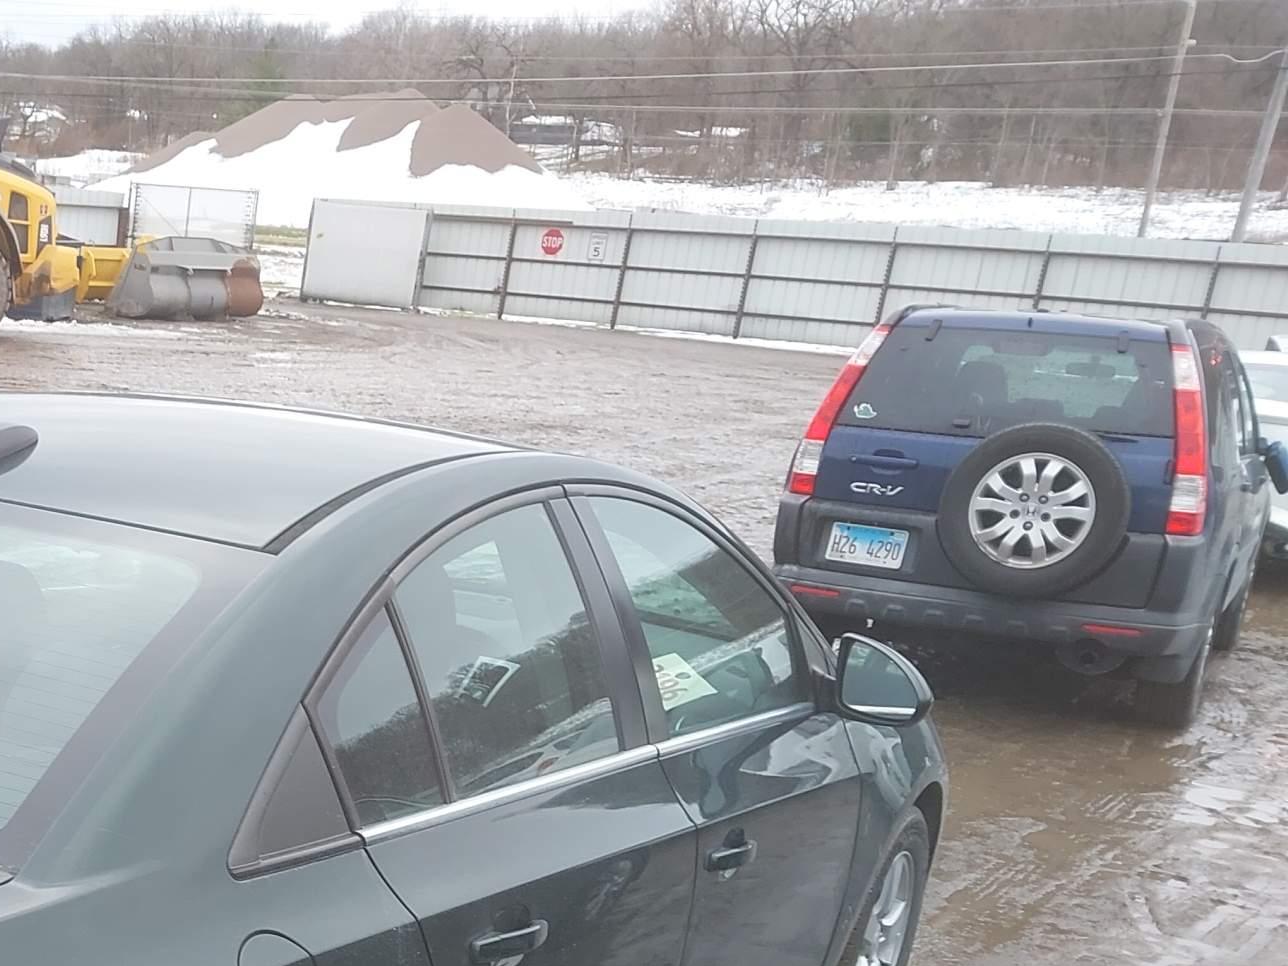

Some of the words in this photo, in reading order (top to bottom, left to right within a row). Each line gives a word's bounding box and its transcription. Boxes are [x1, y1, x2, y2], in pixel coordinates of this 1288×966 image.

[542, 236, 563, 248] STOP
[592, 246, 601, 257] 5
[850, 482, 904, 496] CR-V
[831, 534, 857, 555] H26
[867, 540, 902, 561] 4290
